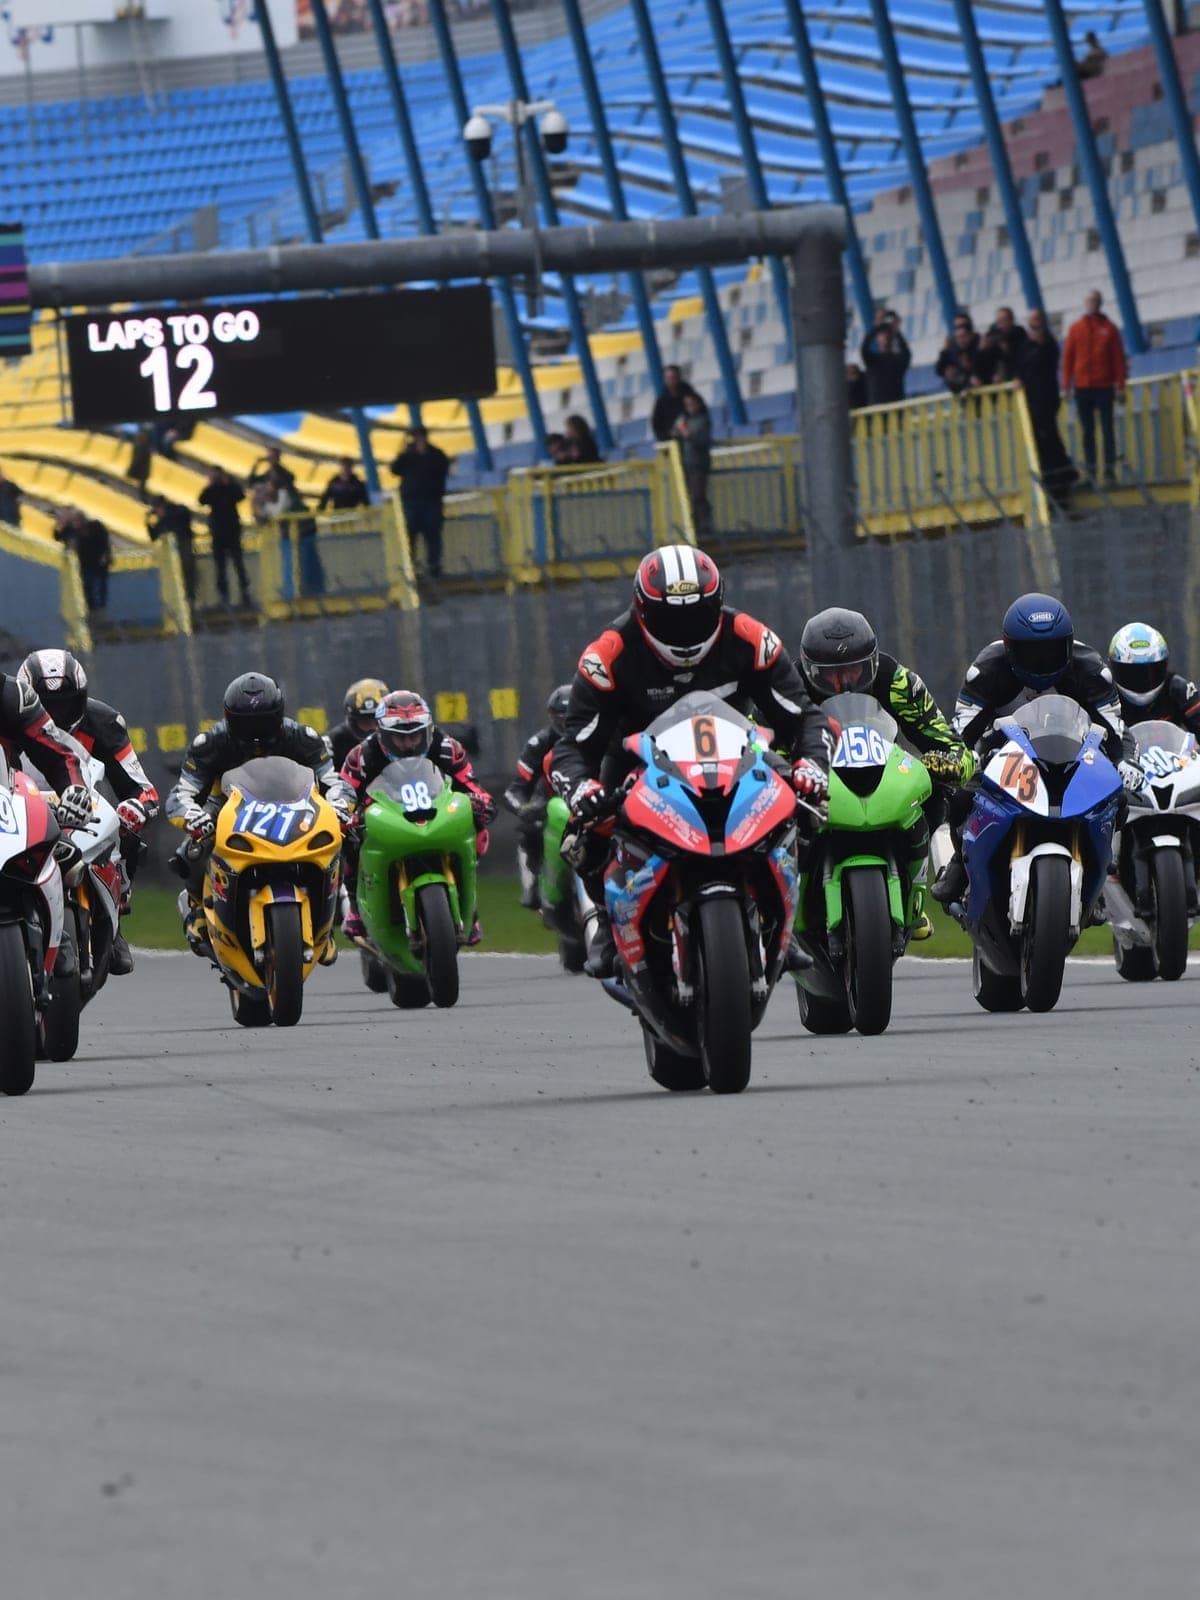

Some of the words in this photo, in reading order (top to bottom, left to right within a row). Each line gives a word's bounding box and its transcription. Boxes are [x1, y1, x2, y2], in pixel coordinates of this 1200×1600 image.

[87, 317, 164, 352] LAPS
[166, 313, 209, 346] TO
[212, 309, 260, 343] GO
[139, 343, 217, 412] 12
[693, 718, 716, 757] 6
[401, 781, 432, 812] 98
[999, 751, 1038, 801] 73
[239, 800, 295, 841] 121
